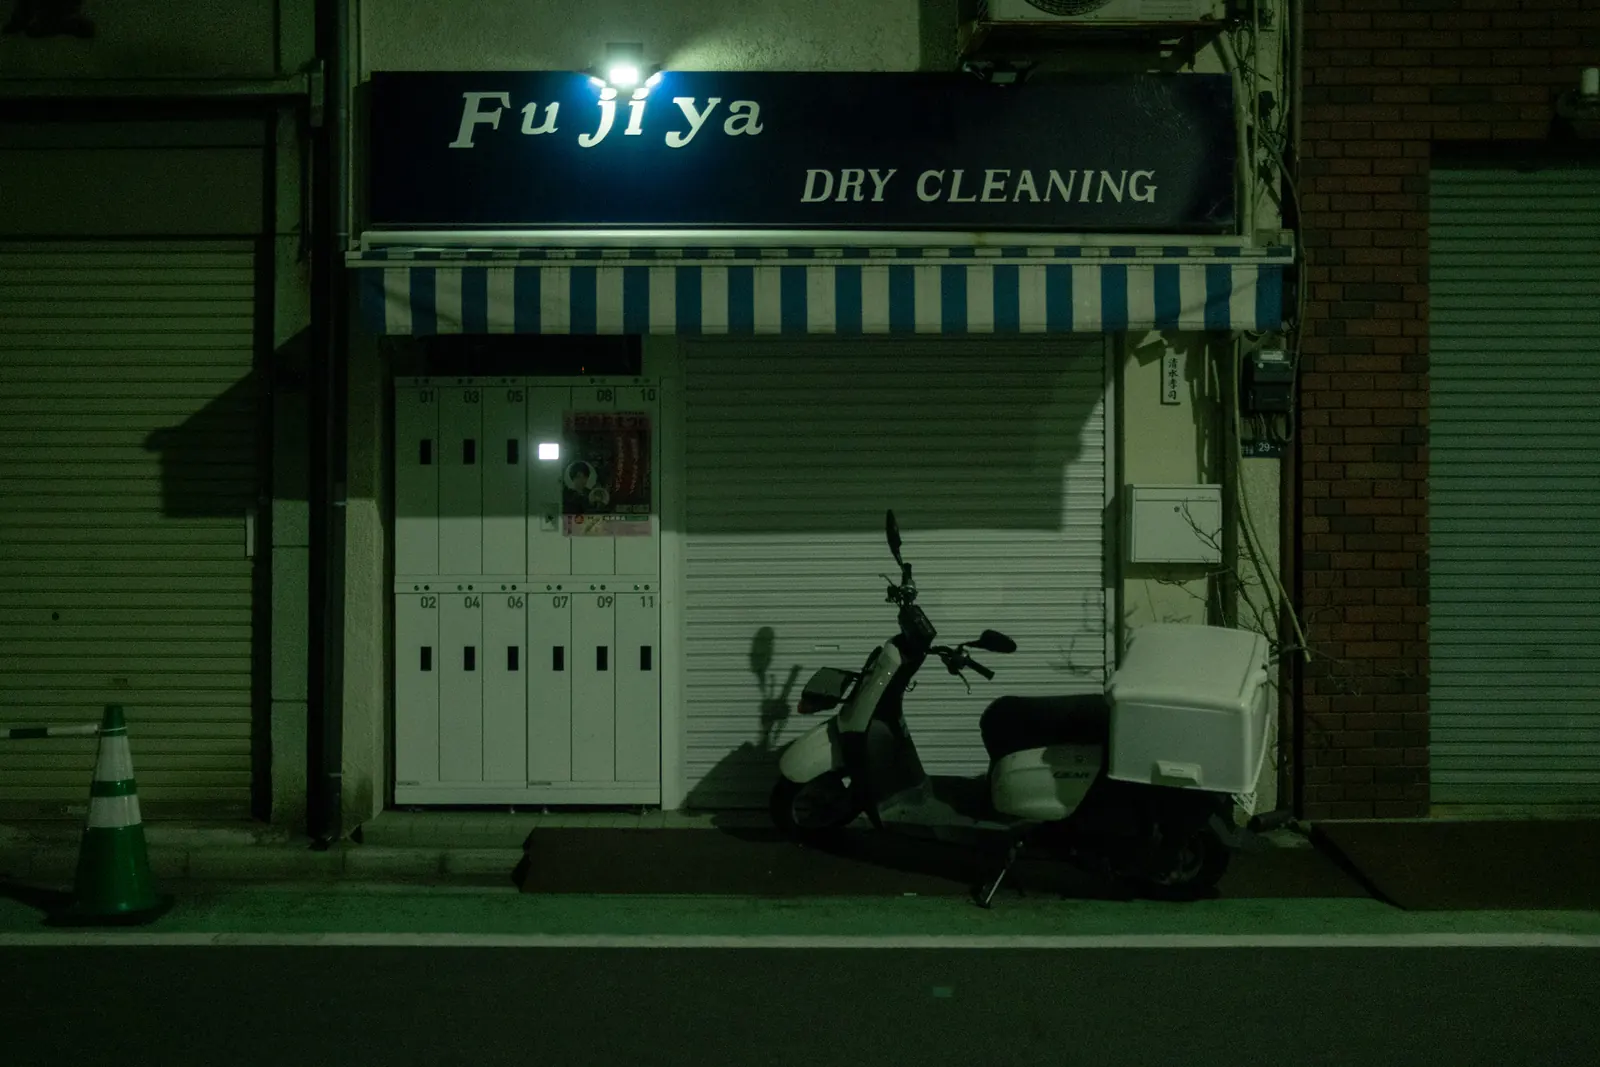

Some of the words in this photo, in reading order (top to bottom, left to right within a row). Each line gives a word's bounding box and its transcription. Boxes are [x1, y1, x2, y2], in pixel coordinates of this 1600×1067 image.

[800, 168, 897, 203] DRY
[916, 169, 1158, 204] CLEANING
[420, 390, 434, 403] 01
[464, 390, 479, 403] 03
[507, 389, 523, 402] 05
[597, 389, 613, 402] 08
[641, 388, 656, 401] 10
[421, 596, 437, 608] 02
[464, 596, 480, 608] 04
[507, 596, 523, 608] 06
[553, 596, 568, 608] 07
[597, 596, 613, 608] 09
[641, 596, 654, 608] 11
